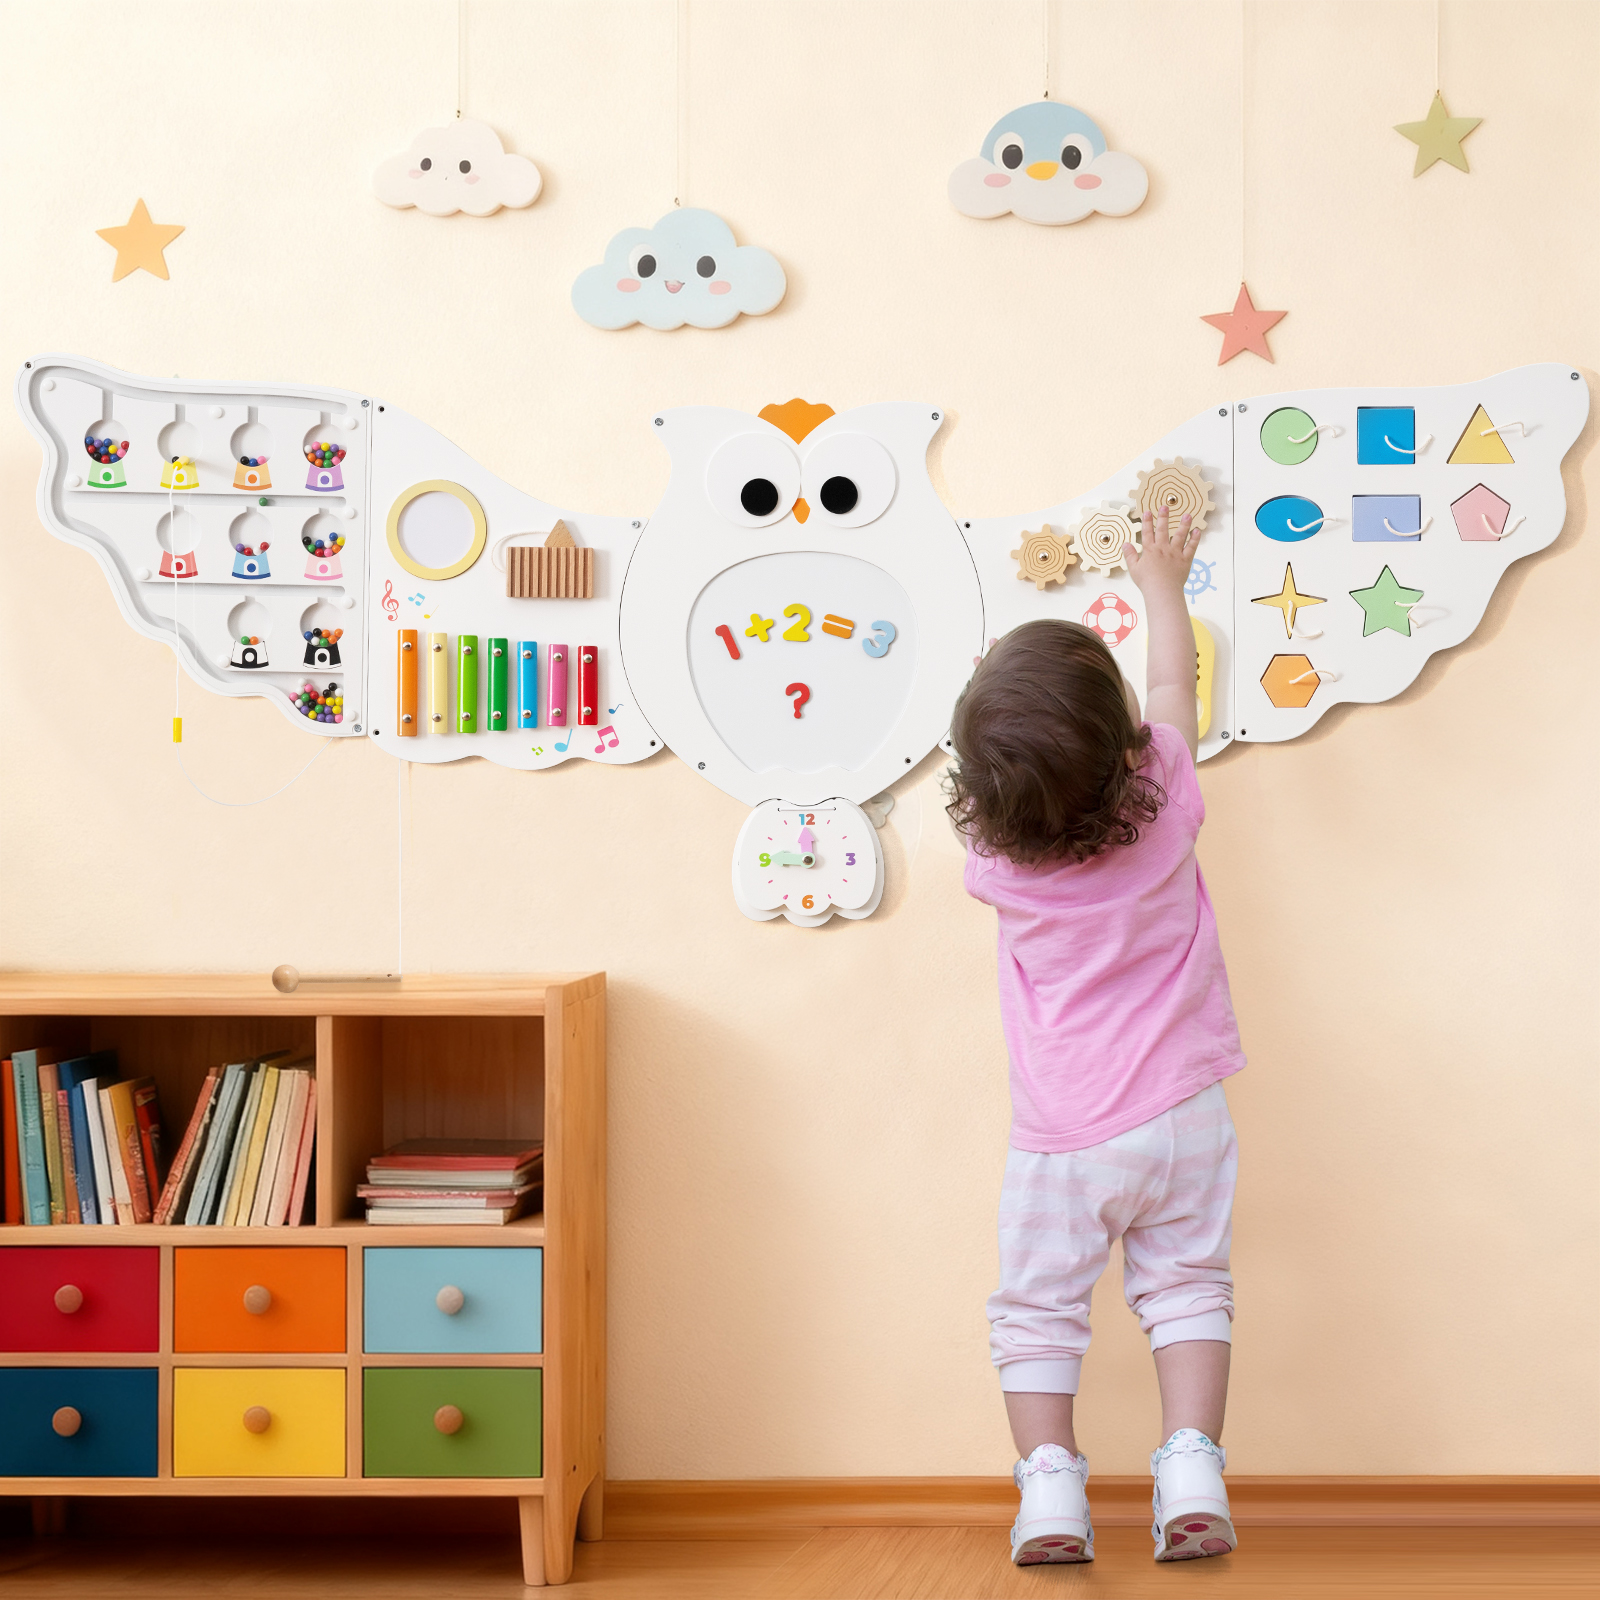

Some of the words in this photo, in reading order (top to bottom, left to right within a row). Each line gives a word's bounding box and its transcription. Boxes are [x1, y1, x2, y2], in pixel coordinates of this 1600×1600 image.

[785, 682, 810, 719] ?
[799, 813, 816, 826] 12
[759, 853, 771, 867] 9
[845, 853, 856, 866] 3
[802, 895, 814, 909] 6
